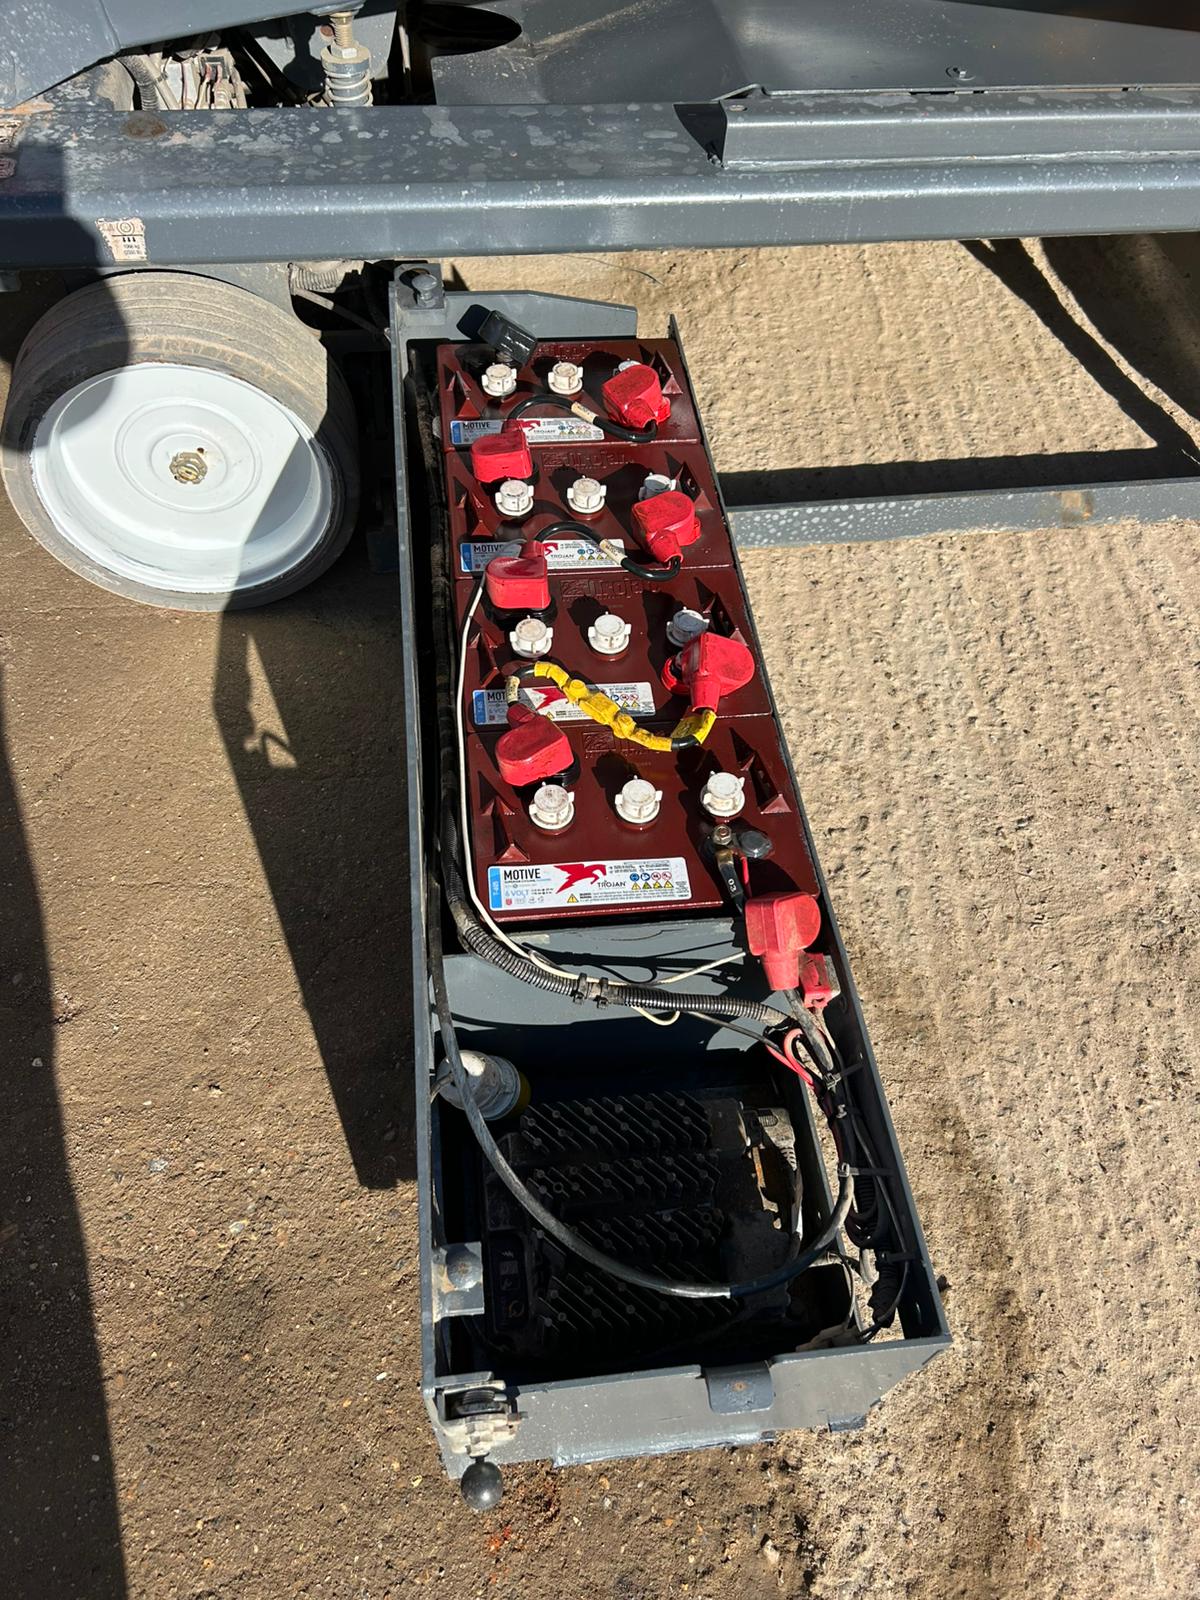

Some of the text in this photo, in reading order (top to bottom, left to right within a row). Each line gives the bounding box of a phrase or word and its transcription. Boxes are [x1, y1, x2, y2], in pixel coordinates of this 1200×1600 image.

[462, 421, 490, 430] MOTIVE
[503, 868, 541, 881] MOTIVE
[597, 880, 626, 888] TROJAN
